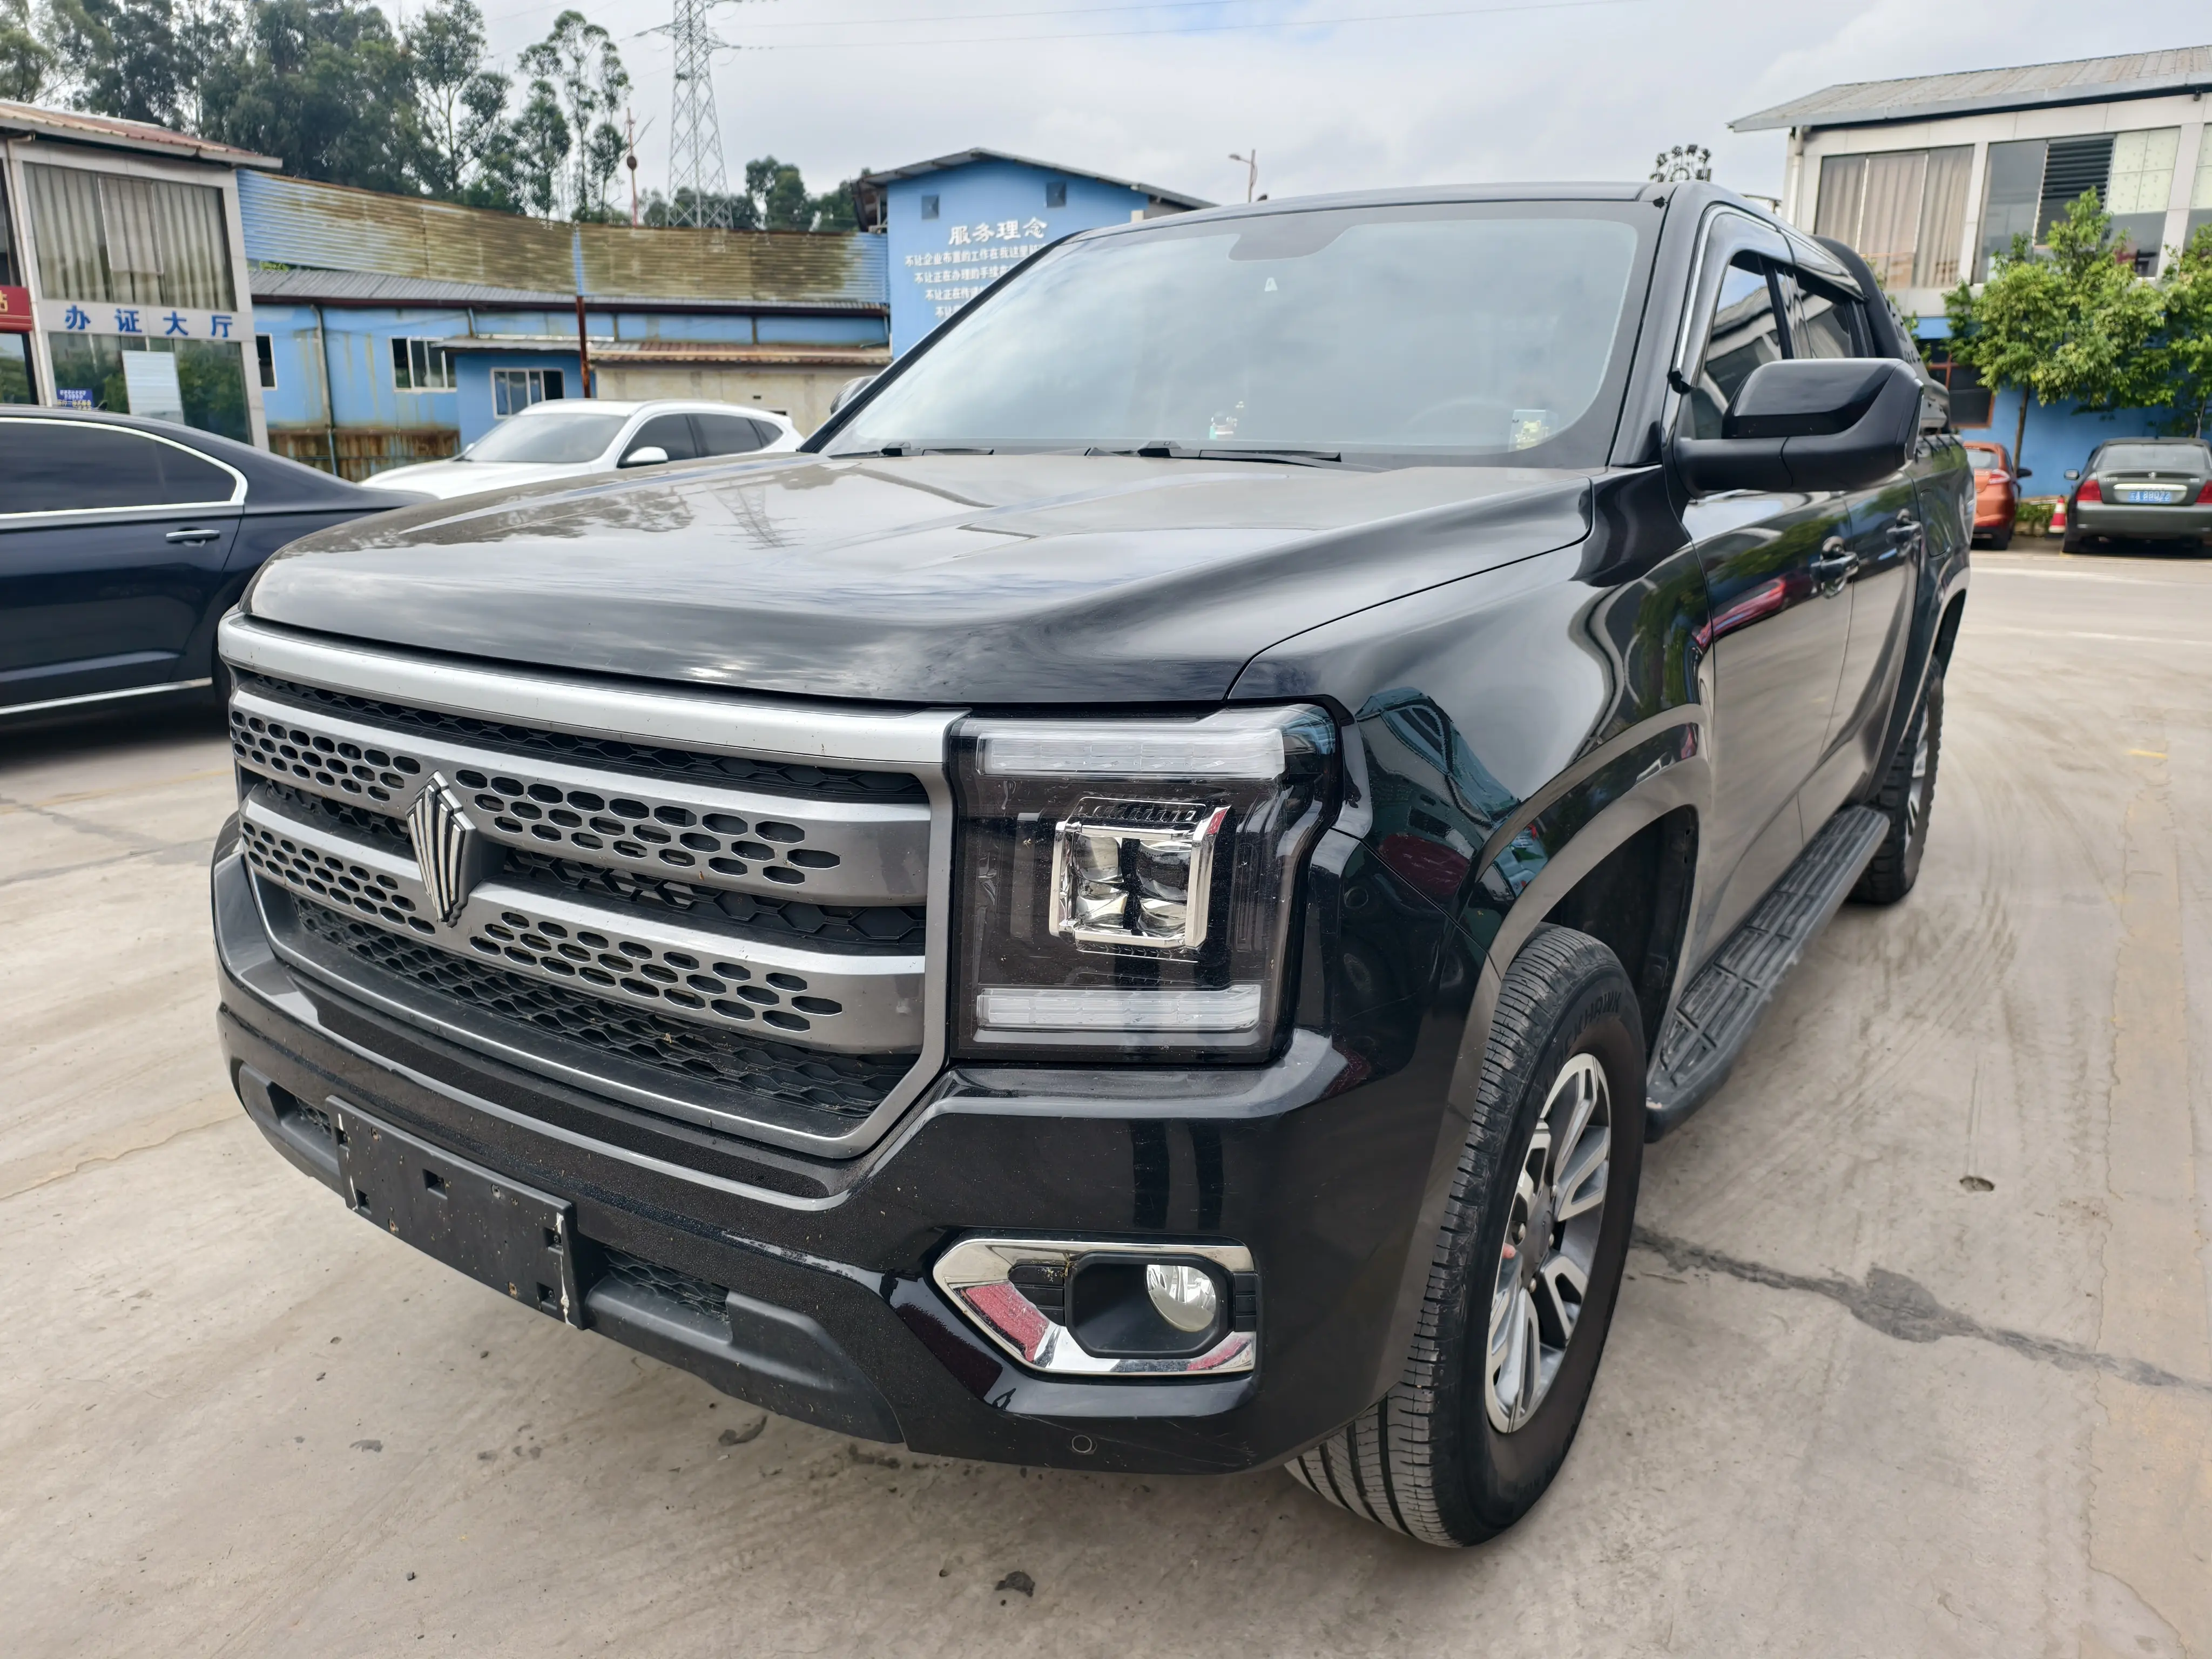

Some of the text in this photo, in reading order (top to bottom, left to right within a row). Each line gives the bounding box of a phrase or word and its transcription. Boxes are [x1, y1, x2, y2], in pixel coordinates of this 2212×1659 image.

[948, 216, 1048, 246] 服务理念
[905, 243, 1048, 267] 不让企业布置的工作在我这里
[65, 304, 233, 338] 办证大厅
